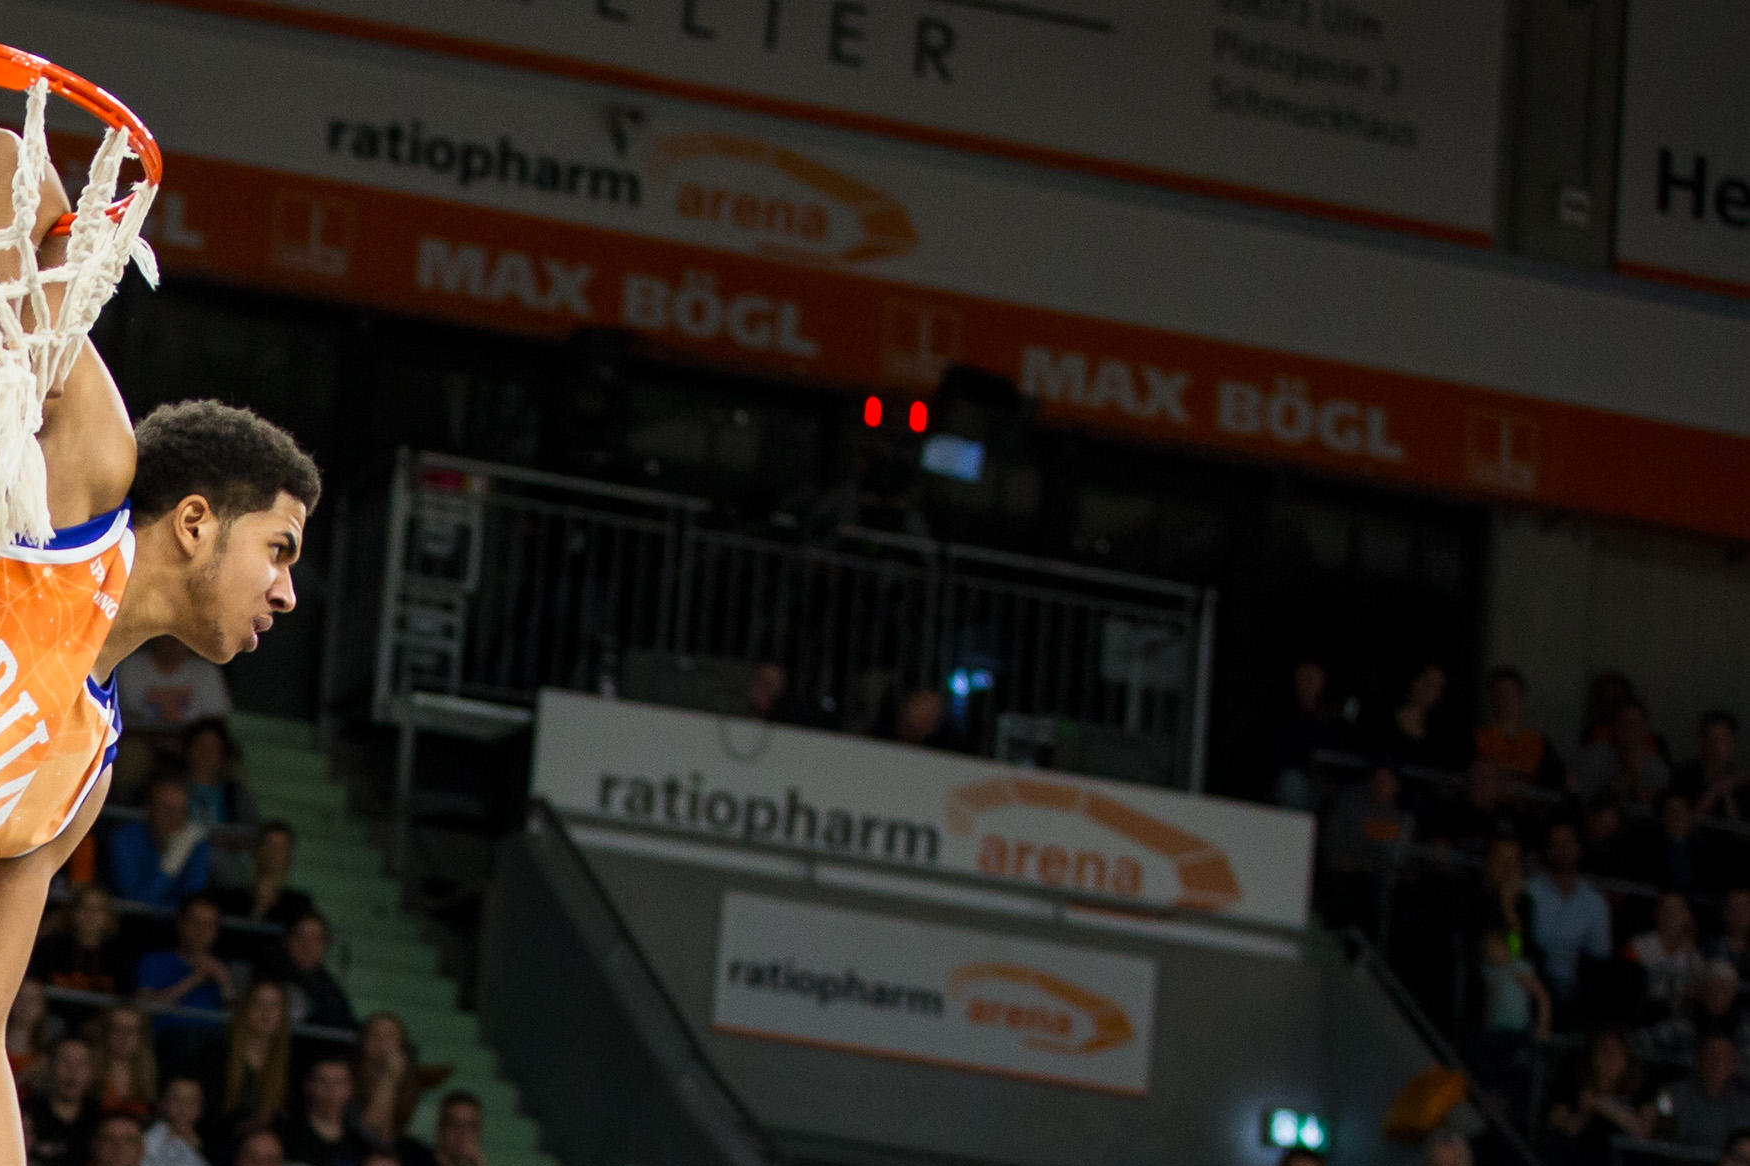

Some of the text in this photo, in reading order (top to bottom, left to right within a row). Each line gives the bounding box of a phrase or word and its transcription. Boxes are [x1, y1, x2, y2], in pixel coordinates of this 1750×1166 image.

[515, 0, 956, 84] LIER
[326, 116, 830, 243] ratiopharm arena
[417, 238, 819, 358] MAX BÖGL
[1021, 346, 1407, 463] MAX BÖGL
[597, 770, 1144, 898] ratiopharm arena
[726, 955, 1075, 1039] ratiopharm arena
